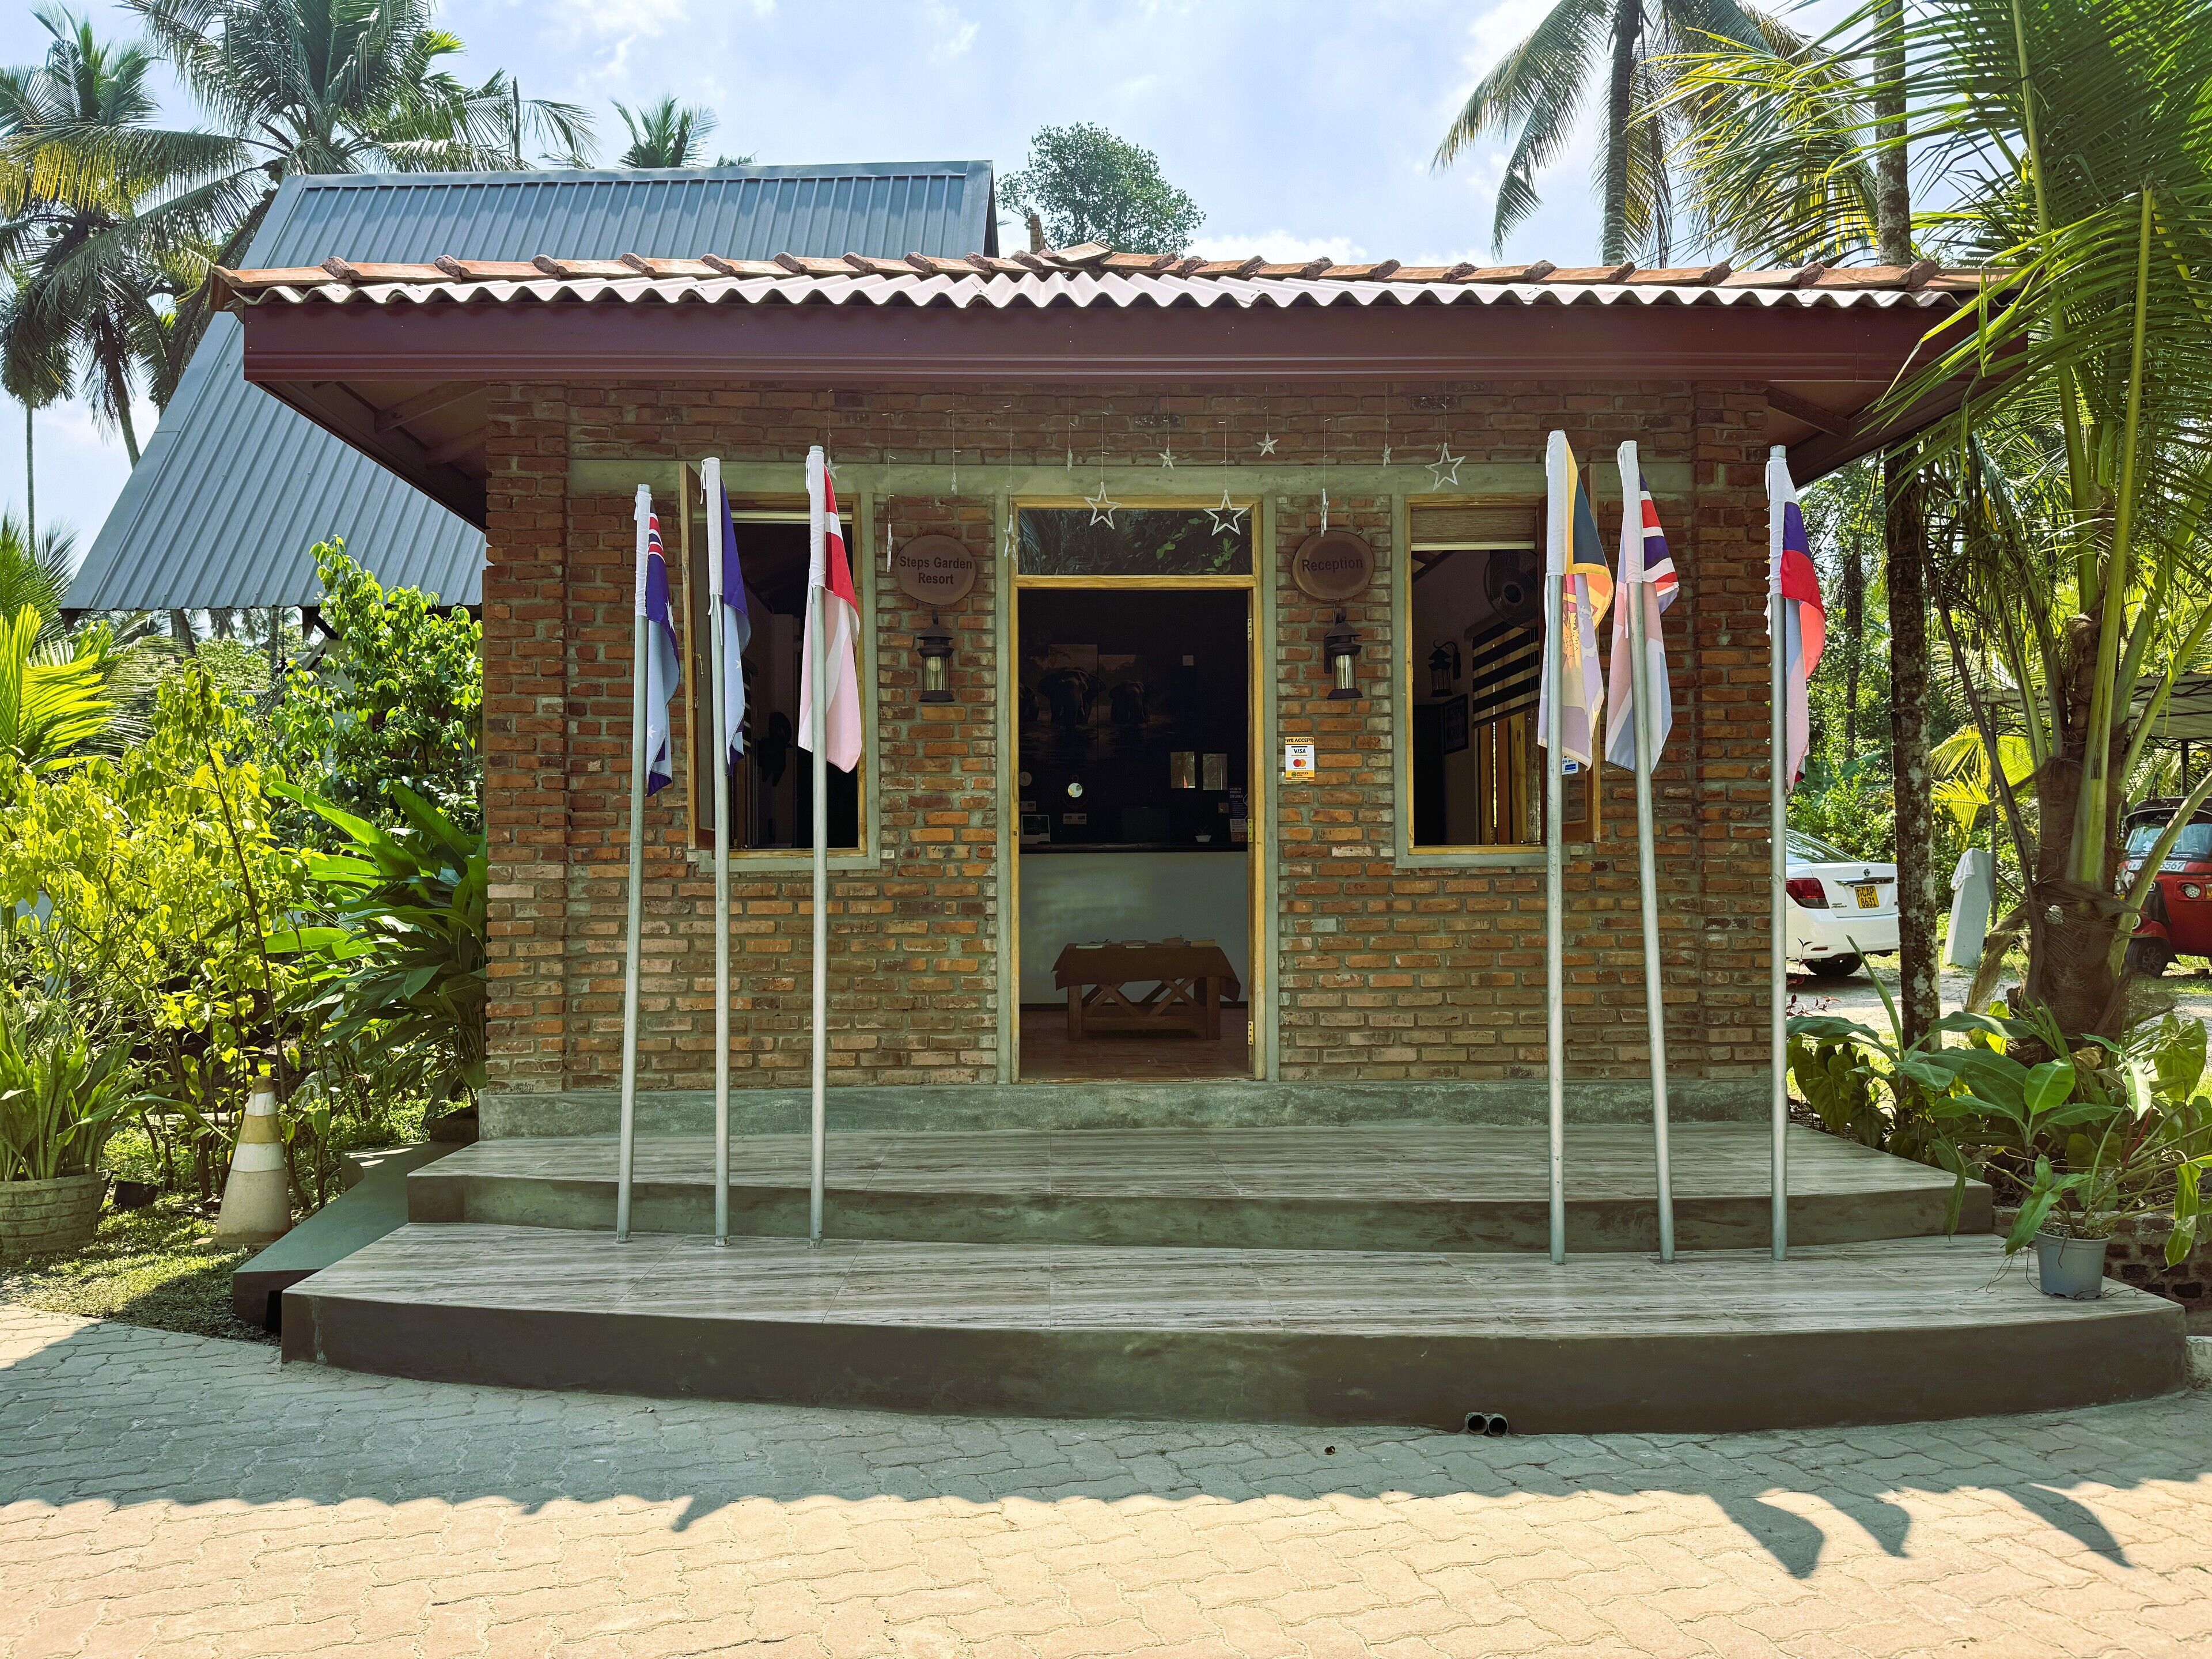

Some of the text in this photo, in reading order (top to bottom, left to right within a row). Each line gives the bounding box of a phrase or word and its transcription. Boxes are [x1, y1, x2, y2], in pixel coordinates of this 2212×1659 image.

[900, 556, 972, 570] Steps Garden
[1302, 557, 1363, 573] Reception
[918, 572, 954, 585] Resort
[1861, 897, 1877, 907] 8631
